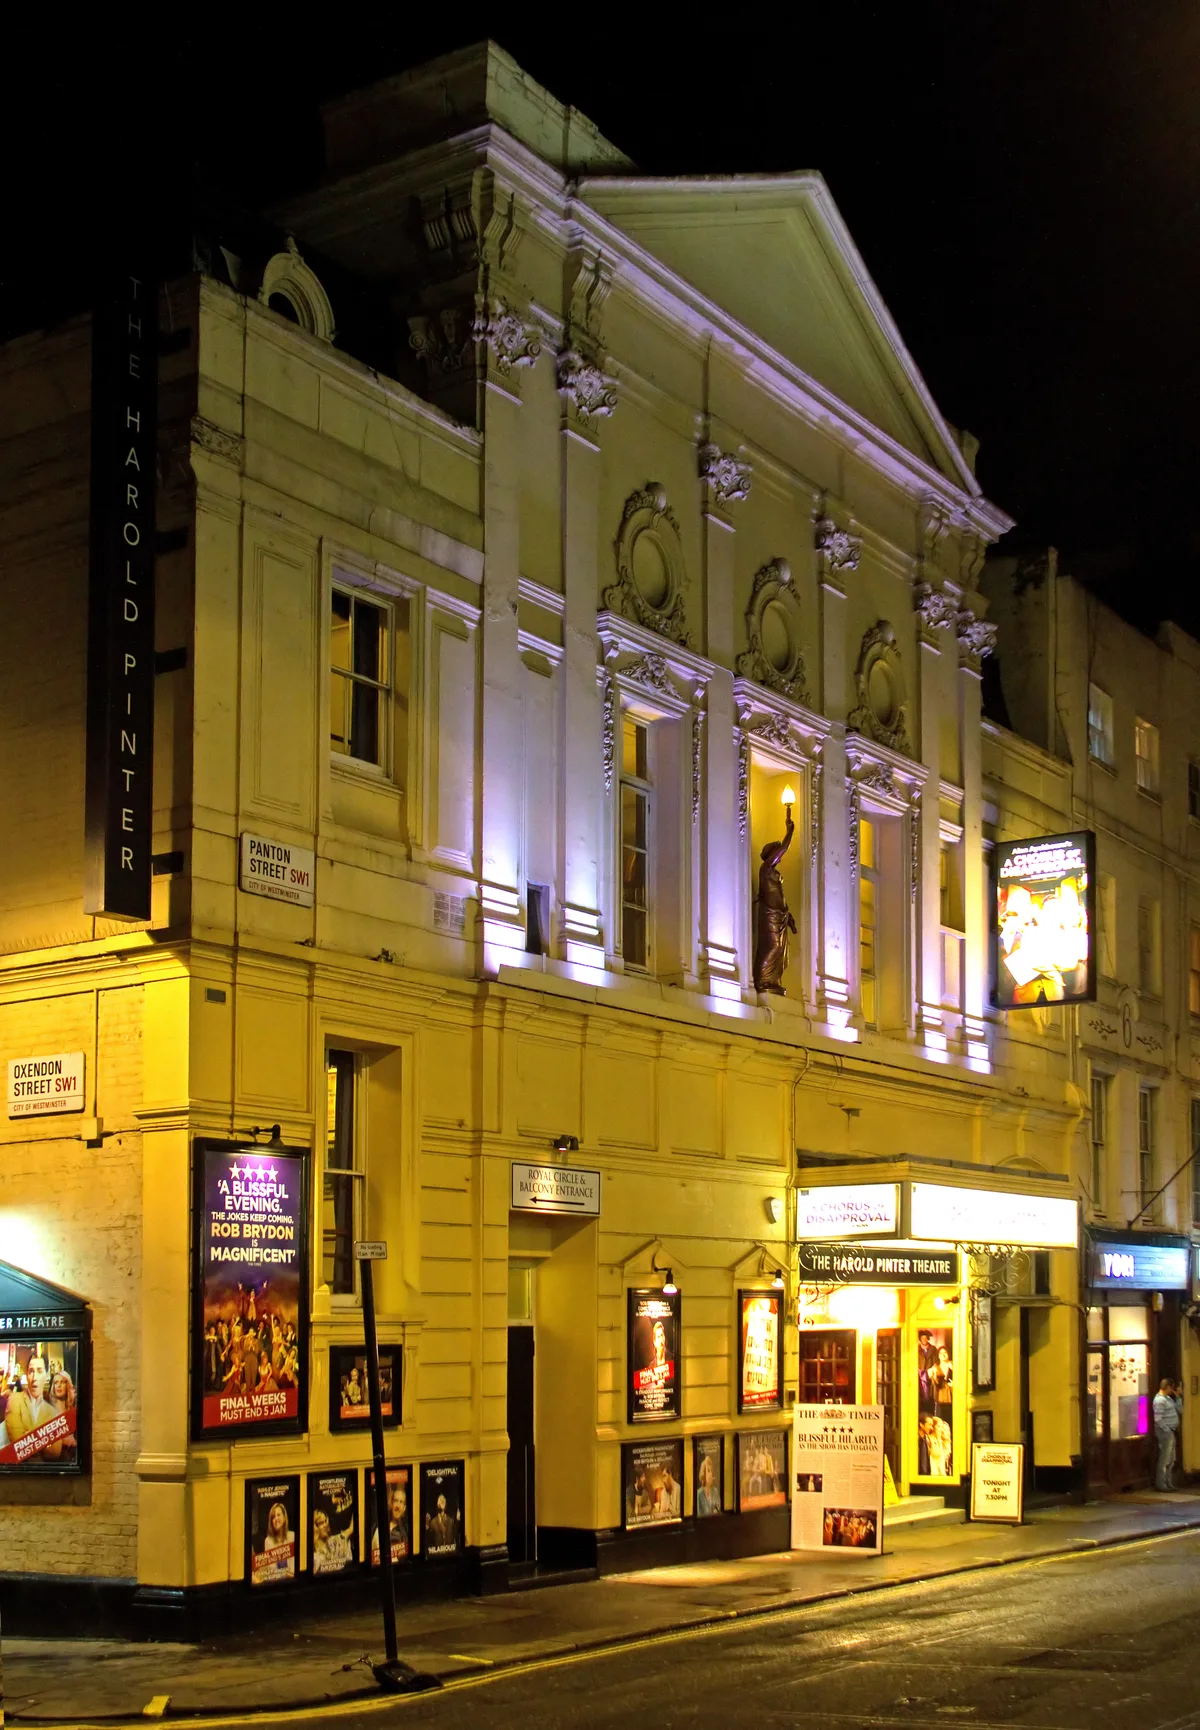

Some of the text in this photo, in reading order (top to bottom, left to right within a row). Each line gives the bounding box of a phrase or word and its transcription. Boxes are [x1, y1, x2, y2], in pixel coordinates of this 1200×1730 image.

[121, 276, 143, 871] THE HAROLD PINTER
[250, 840, 290, 863] PANTON
[1004, 859, 1013, 867] A
[250, 858, 309, 886] STREET SW1
[249, 881, 259, 890] CITY
[268, 886, 299, 900] WESTMINSTER
[14, 1060, 62, 1079] OXENDON
[14, 1076, 76, 1096] STREET SW1
[33, 1100, 66, 1110] WESTMINSTER
[529, 1169, 585, 1184] ROYAL CIRCLE &
[233, 1181, 289, 1198] BLISSFUL
[520, 1181, 593, 1198] BALCONY ENTRANCE
[225, 1196, 282, 1213] EVENING.
[212, 1212, 294, 1224] THE JOKES KEEP COMING.
[806, 1212, 890, 1223] DISAPPROVAL
[211, 1223, 294, 1240] ROB BRYDON
[211, 1247, 295, 1263] MAGNIFICENT'
[812, 1255, 950, 1274] THE HAROLD PINTER THEATRE
[17, 1316, 64, 1328] THEATRE
[220, 1392, 286, 1410] FINAL WEEKS
[220, 1404, 286, 1421] MUST END 5 JAN
[798, 1410, 880, 1419] THE TIMES
[14, 1415, 67, 1452] FINAL WEEKS
[798, 1434, 878, 1444] BLISSFUL HILARITY
[16, 1425, 69, 1460] MUST END 5 JAN
[255, 1545, 290, 1562] FINAL WEEKS
[281, 1551, 291, 1560] JAN
